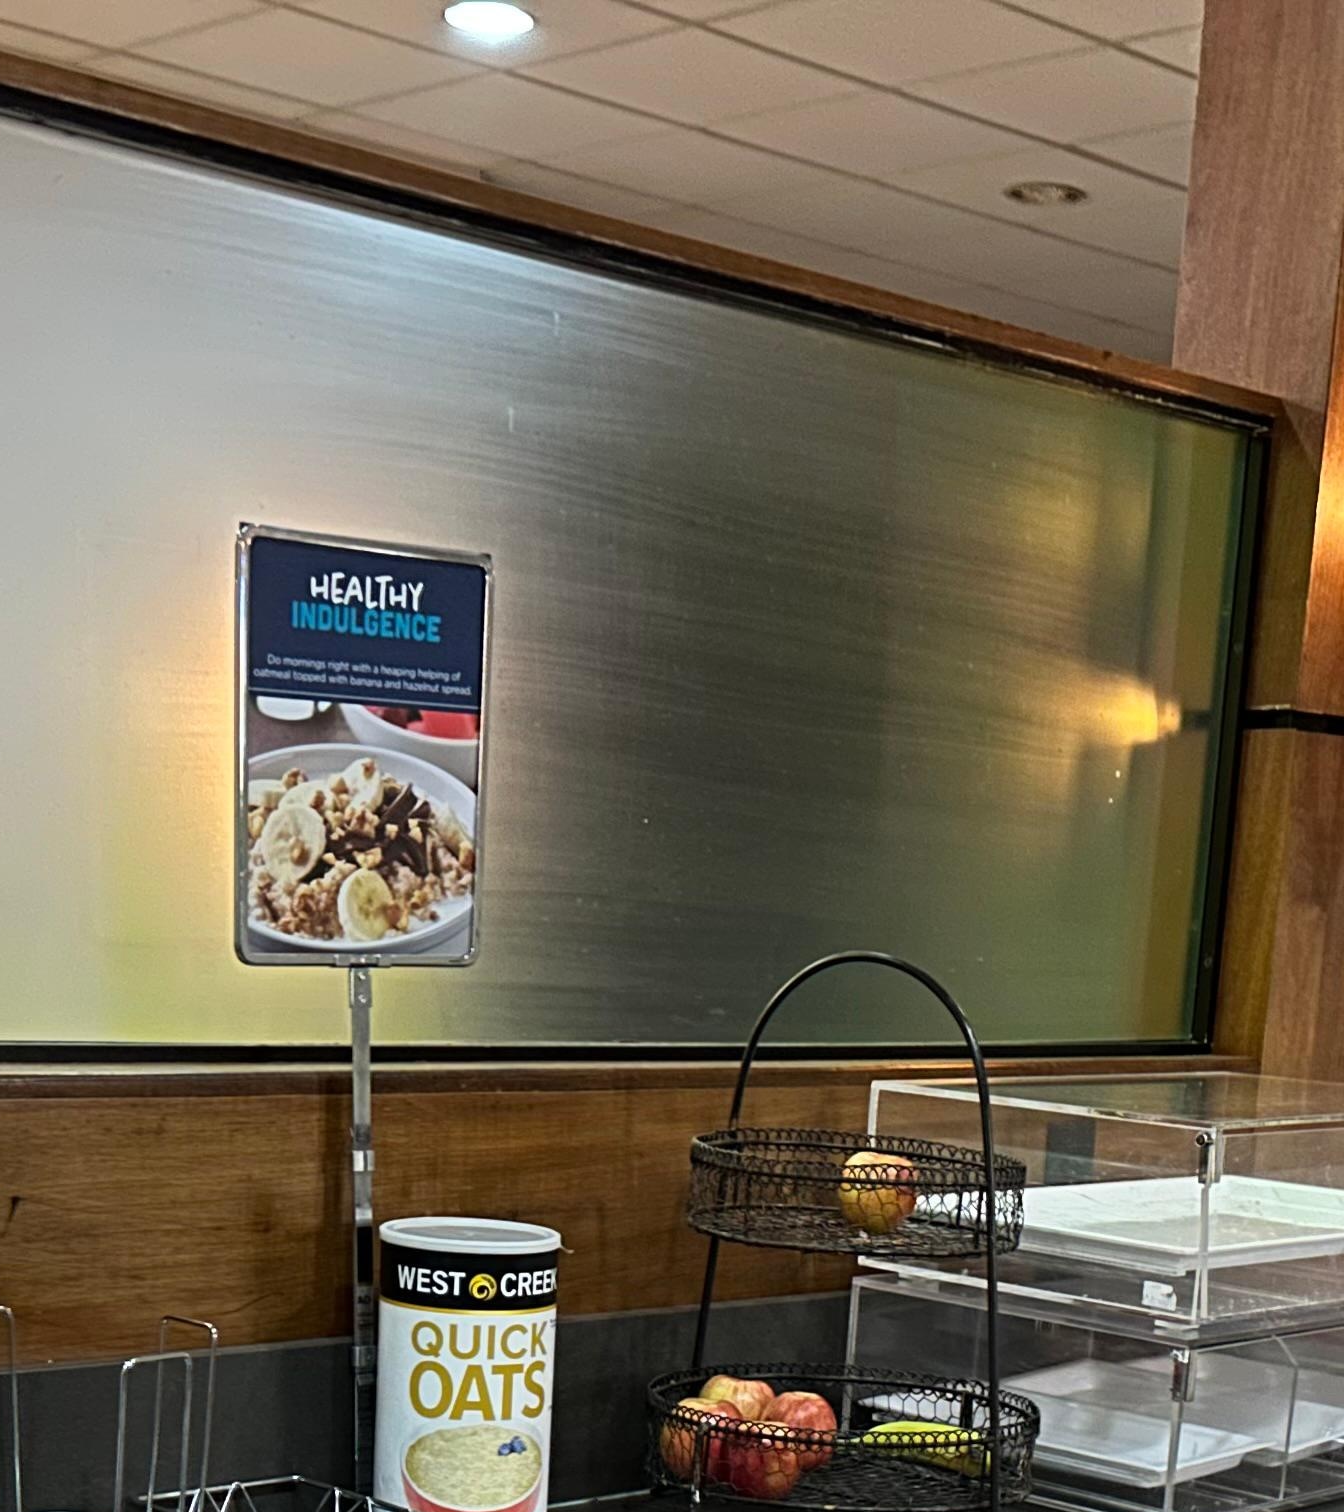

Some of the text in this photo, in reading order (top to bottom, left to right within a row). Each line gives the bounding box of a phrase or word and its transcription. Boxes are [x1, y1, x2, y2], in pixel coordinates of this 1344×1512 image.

[310, 571, 424, 612] HEALTHY
[291, 600, 442, 643] INDULGENCE
[252, 668, 292, 680] oatmeal
[292, 670, 327, 683] topped
[328, 674, 349, 685] with
[349, 674, 383, 688] banana
[384, 679, 401, 689] and
[402, 680, 440, 693] hazelnut
[267, 653, 282, 665] Do
[283, 656, 326, 671] mornings
[327, 660, 350, 672] right
[351, 662, 371, 673] with
[380, 664, 416, 679] heaping
[417, 667, 450, 682] helping
[451, 671, 461, 682] of
[397, 1264, 466, 1296] WEST
[411, 1320, 547, 1359] QUICK
[409, 1360, 546, 1422] OATS
